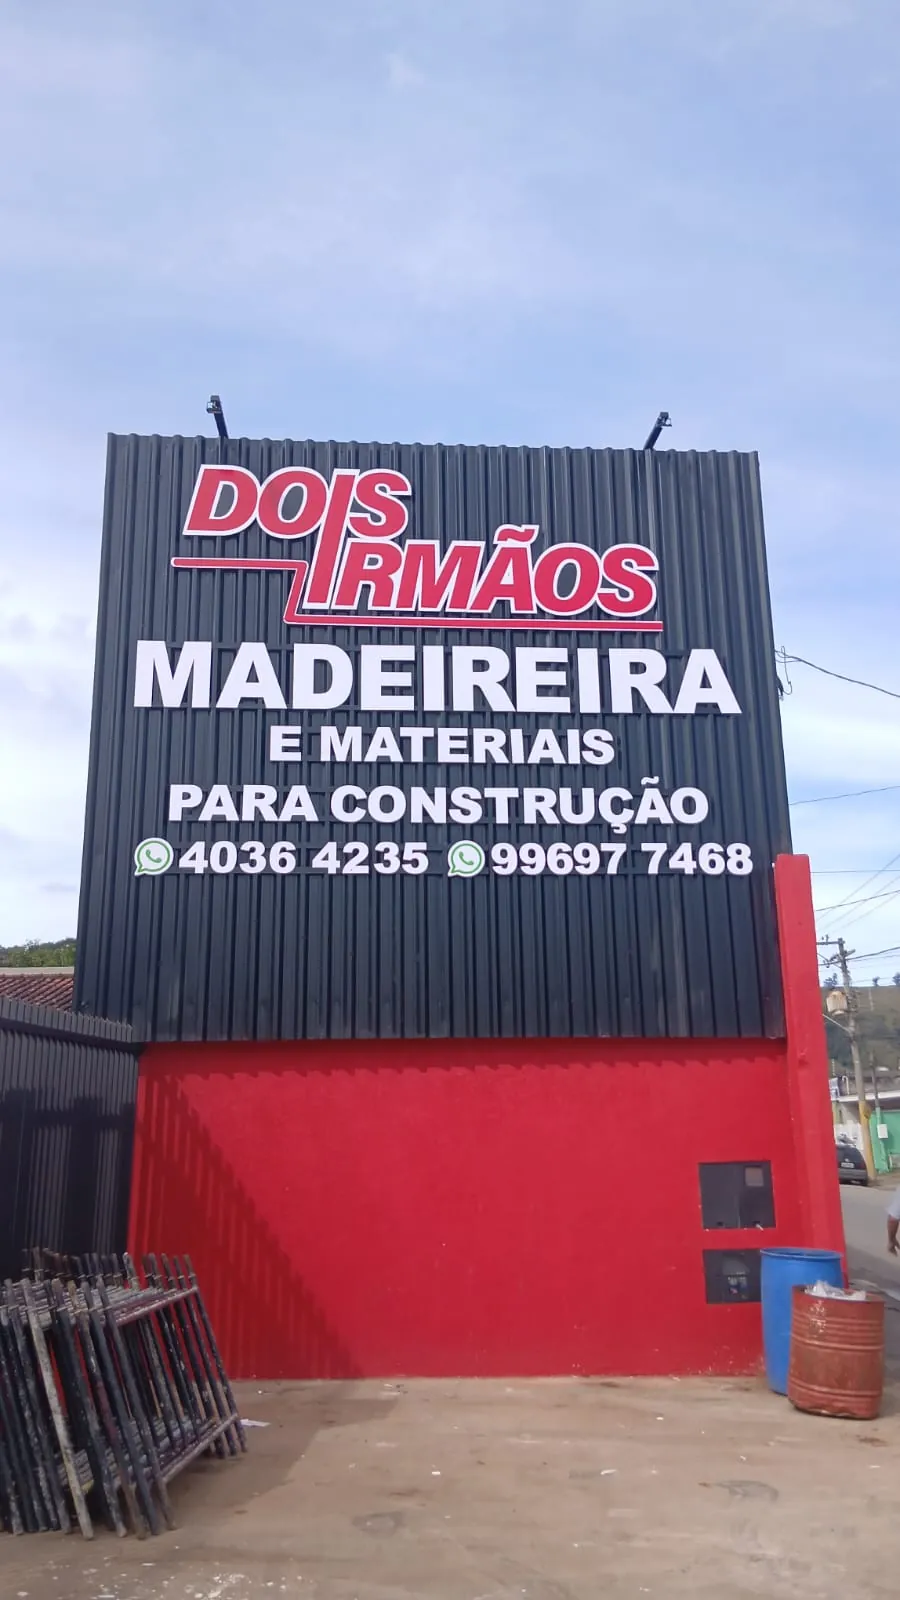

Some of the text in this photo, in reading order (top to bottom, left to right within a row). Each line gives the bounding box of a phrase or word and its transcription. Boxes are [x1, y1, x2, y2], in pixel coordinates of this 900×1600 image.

[183, 464, 411, 540] DOIS
[302, 525, 659, 617] IRMÃOS
[134, 640, 741, 714] MADEIREIRA
[270, 725, 614, 764] E MATERIAIS
[168, 776, 708, 834] PARA CONSTRUÇÃO
[179, 841, 753, 876] 4036 4235 99697 7468
